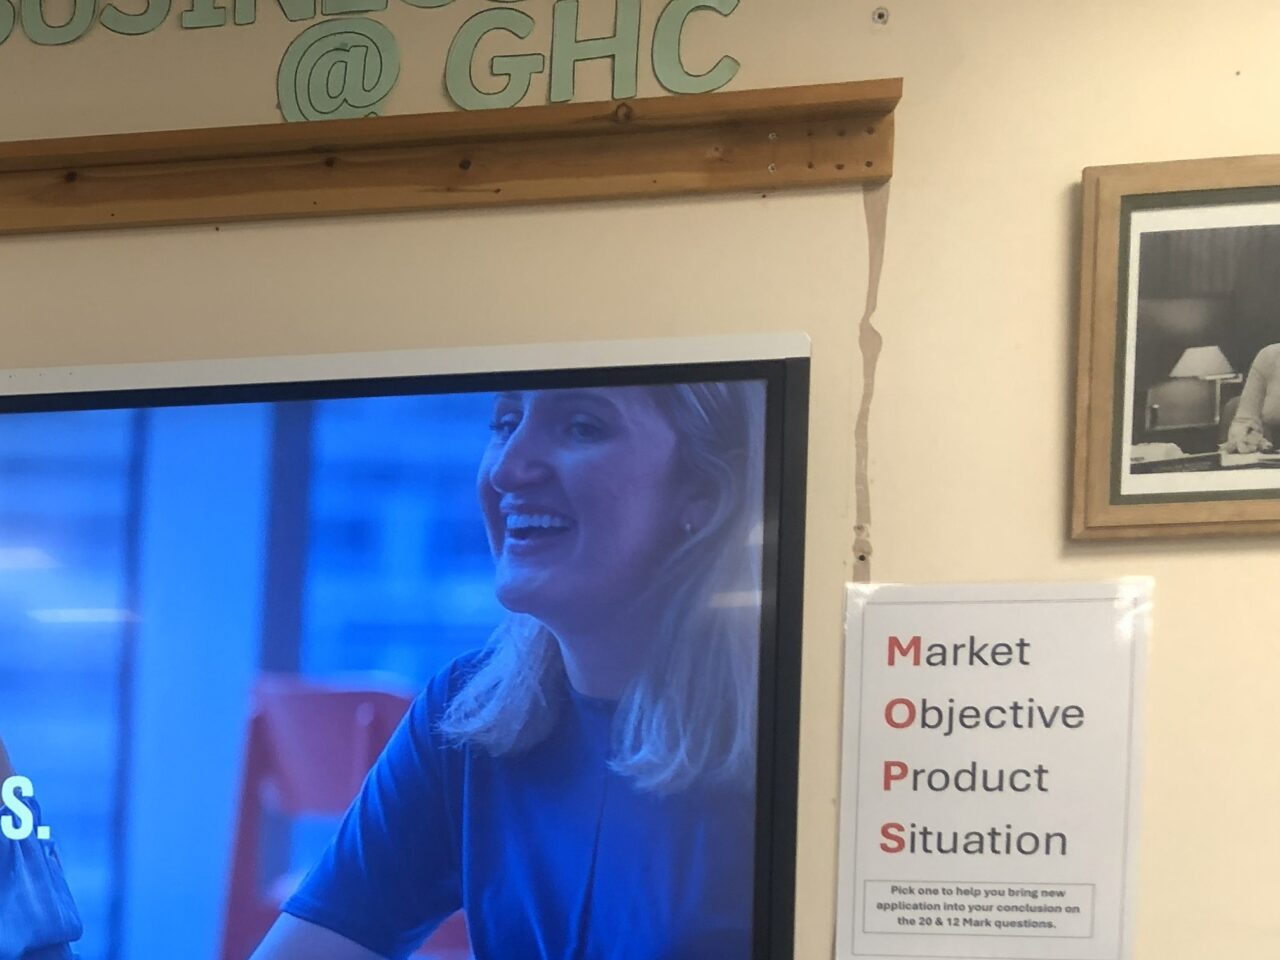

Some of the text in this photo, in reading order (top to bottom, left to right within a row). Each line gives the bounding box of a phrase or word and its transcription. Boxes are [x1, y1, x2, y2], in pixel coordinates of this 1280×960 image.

[277, 17, 400, 122] @
[445, 0, 740, 112] GHC
[886, 635, 1030, 667] Market
[884, 697, 1085, 736] Objective
[882, 760, 1049, 792] Product
[879, 822, 1068, 856] Situation
[876, 901, 1080, 914] application into your conclusion on
[890, 885, 1066, 899] Pick one to help you bring new
[897, 916, 1057, 929] the 20 & 12 Mark questions.
